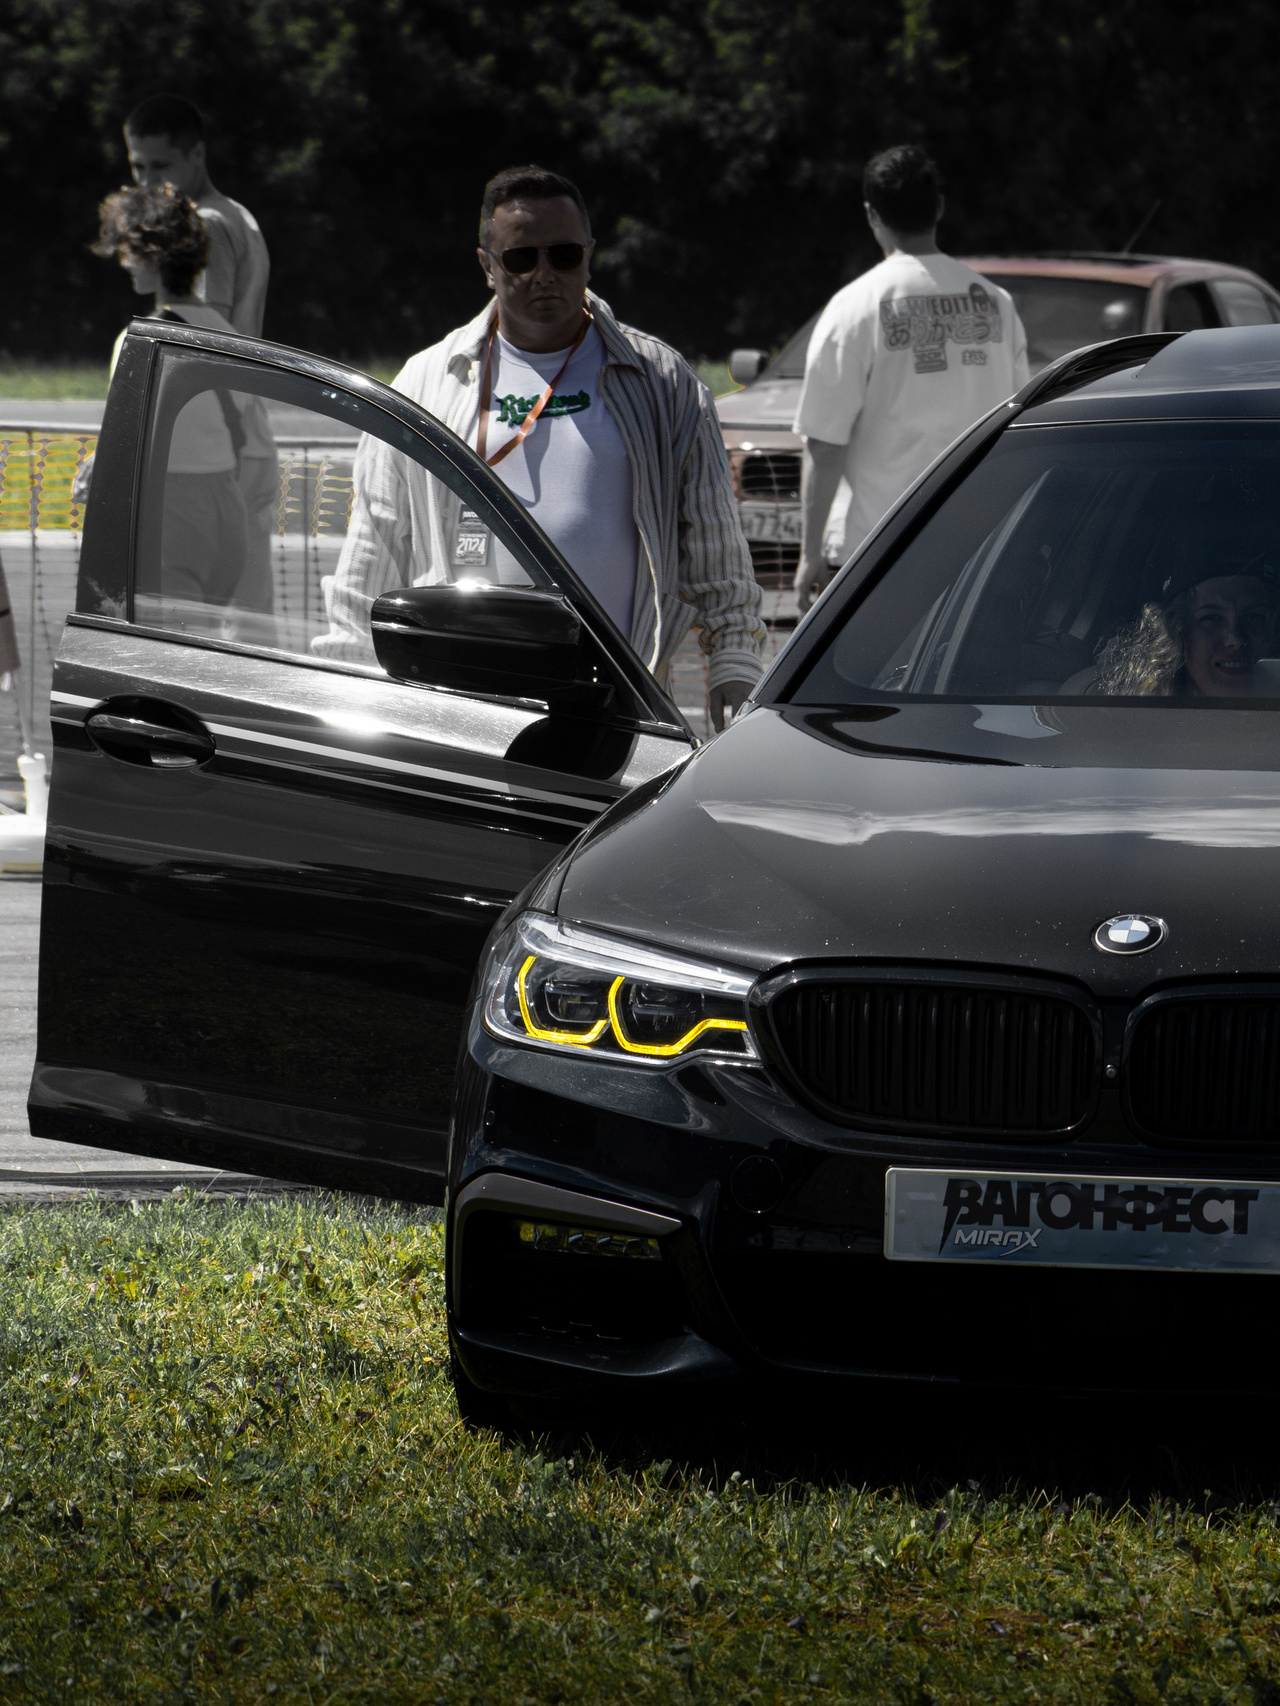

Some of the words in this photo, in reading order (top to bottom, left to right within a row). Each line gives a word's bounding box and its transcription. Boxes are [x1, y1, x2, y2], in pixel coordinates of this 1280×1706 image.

[456, 537, 487, 555] 2024
[939, 1178, 1259, 1255] ВАГОНФЕСТ
[953, 1227, 1043, 1258] MIRAX
